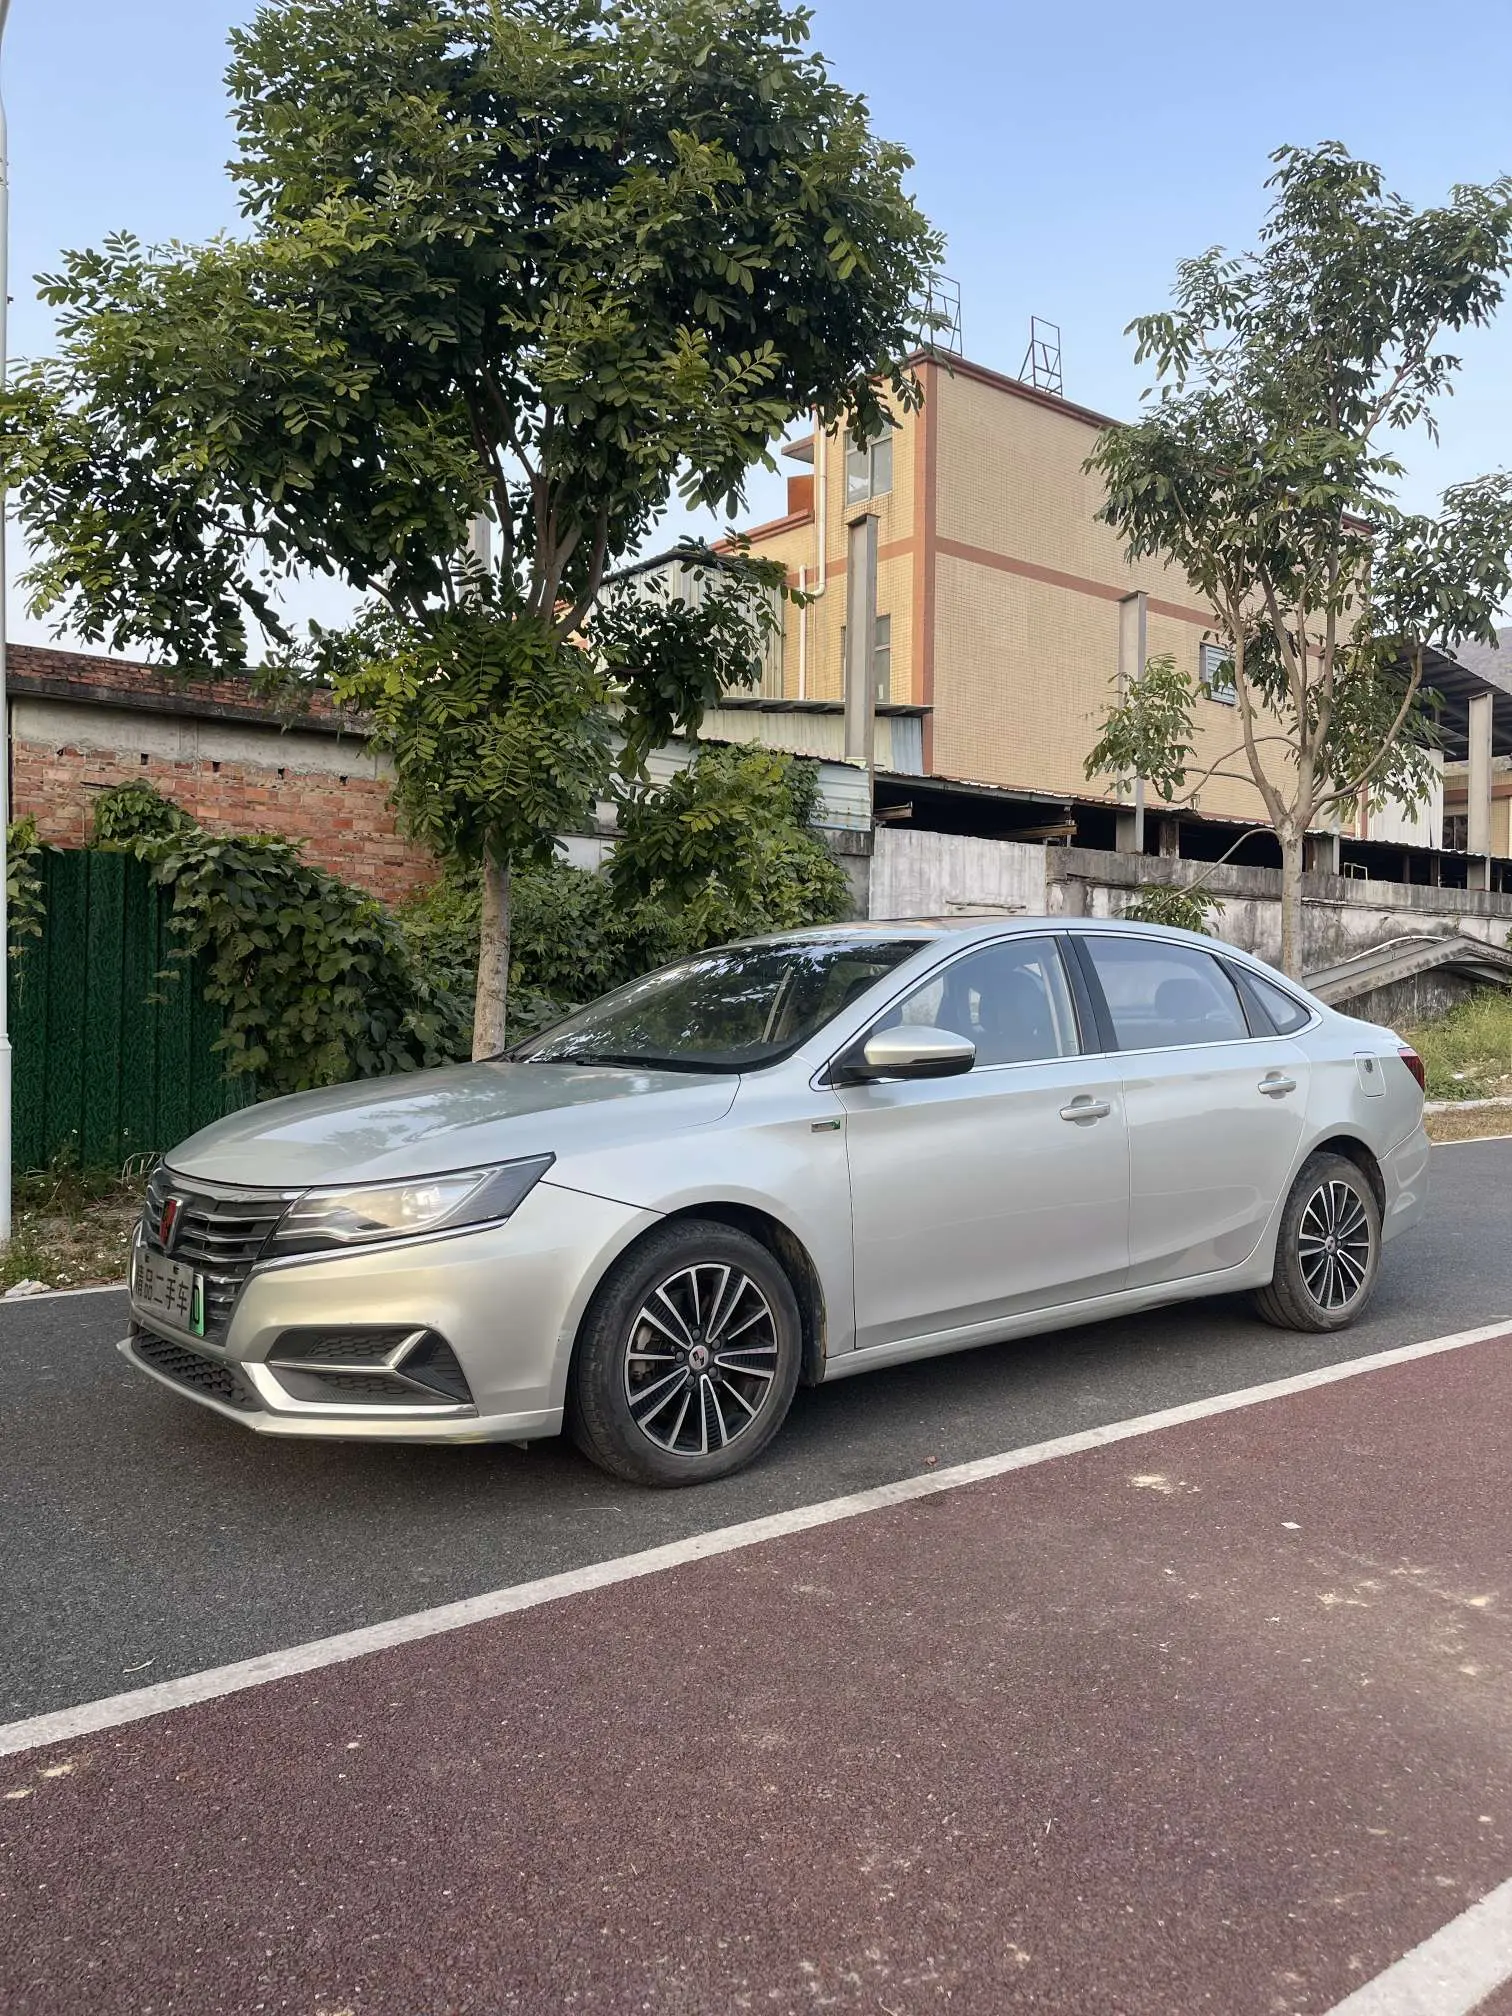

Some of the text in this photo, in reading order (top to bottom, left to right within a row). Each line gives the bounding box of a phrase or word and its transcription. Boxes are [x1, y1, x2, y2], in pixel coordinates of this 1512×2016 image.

[136, 1264, 189, 1316] 精品二手车
